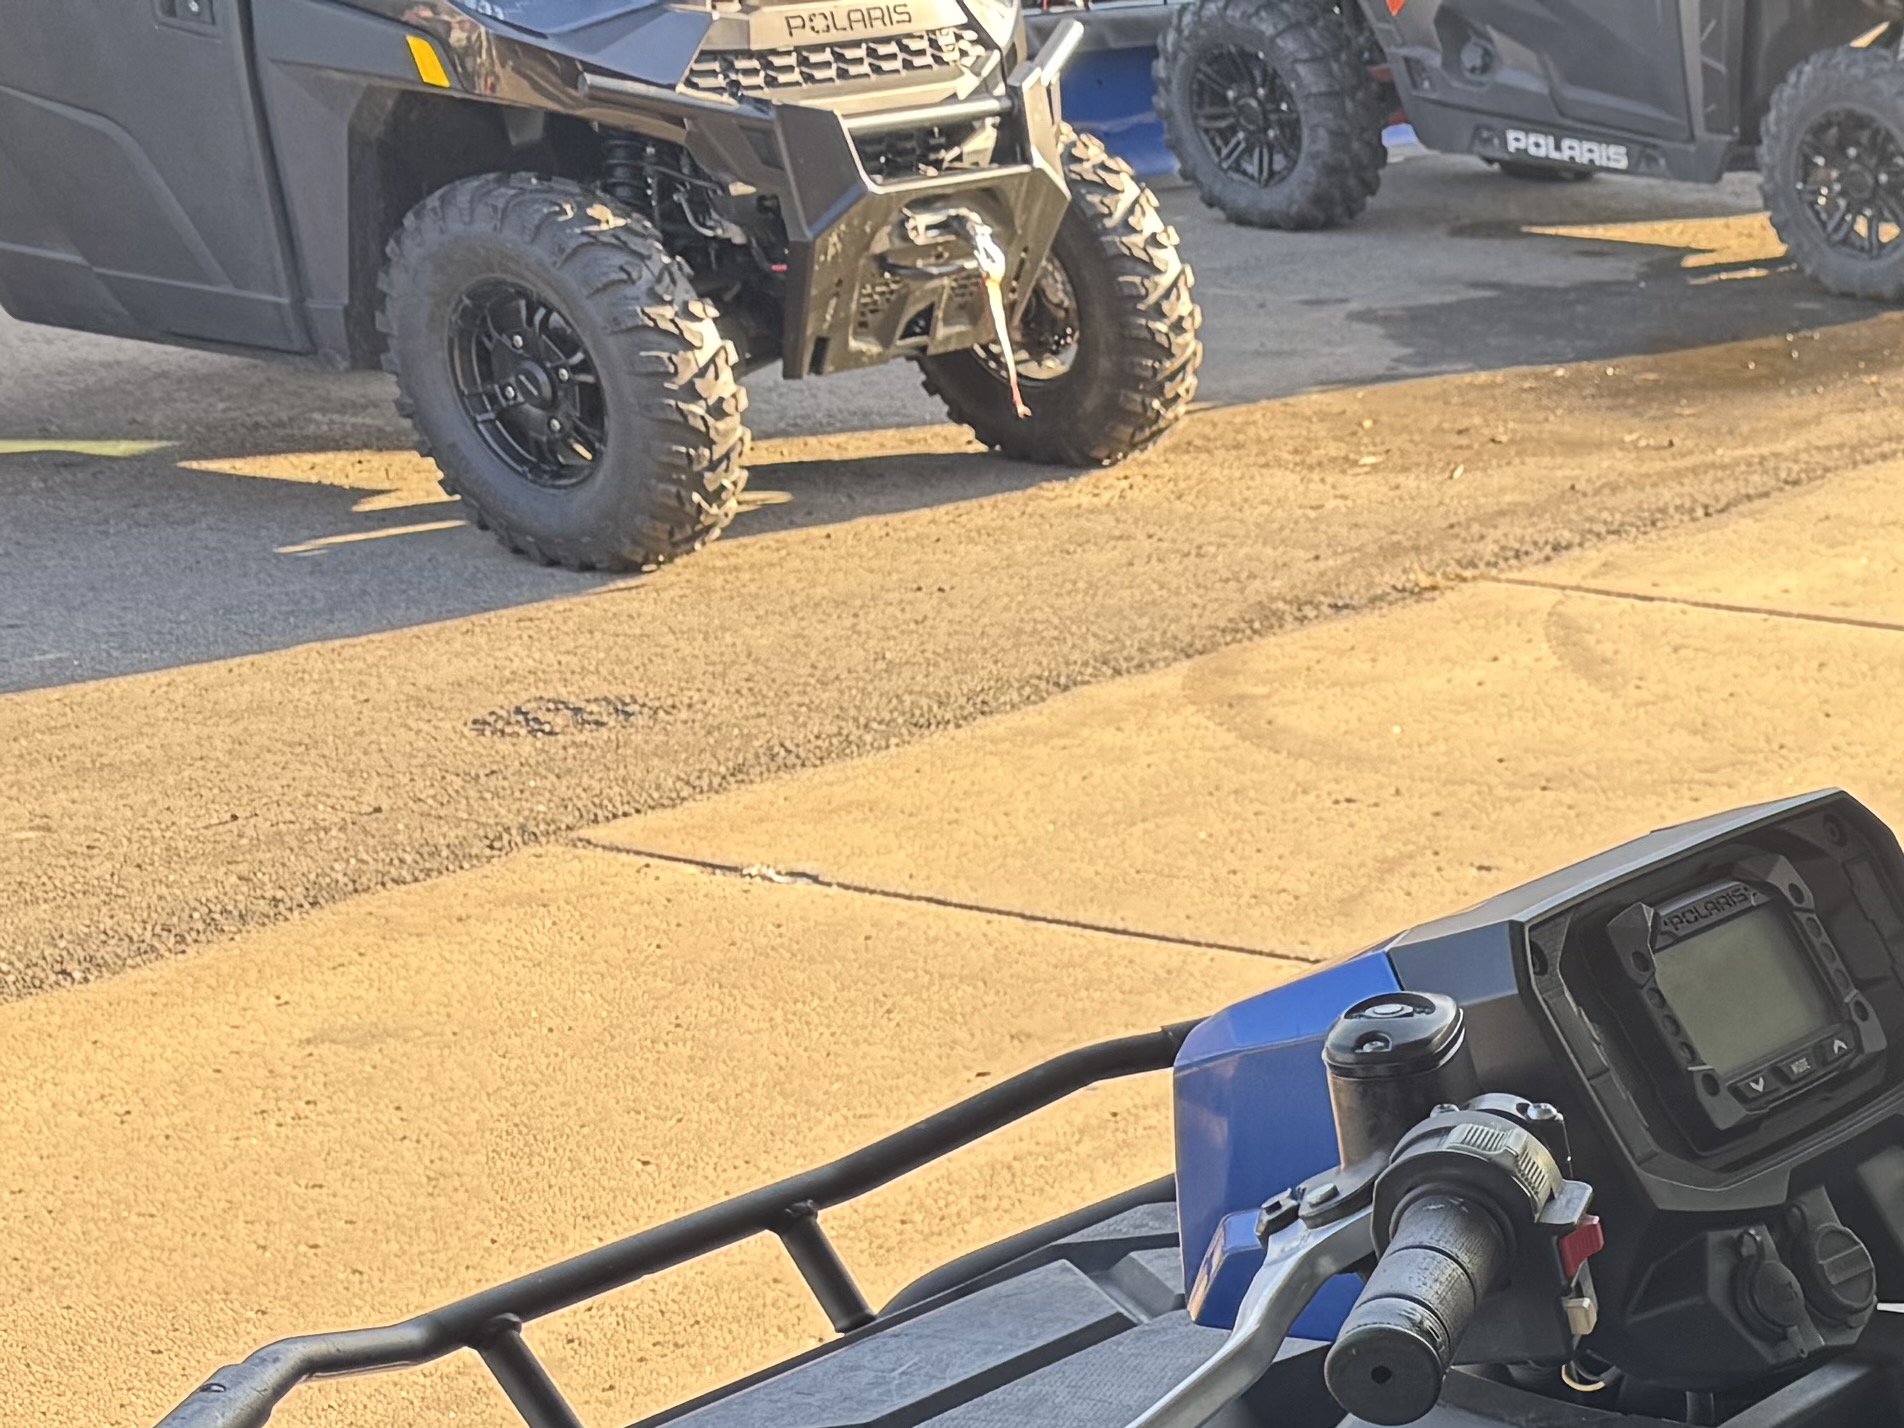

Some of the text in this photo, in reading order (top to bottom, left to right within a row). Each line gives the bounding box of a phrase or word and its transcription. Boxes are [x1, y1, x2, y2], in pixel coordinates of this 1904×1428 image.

[786, 6, 913, 37] POLARIS
[1506, 129, 1629, 170] POLARIS
[1670, 888, 1750, 931] POLARIS
